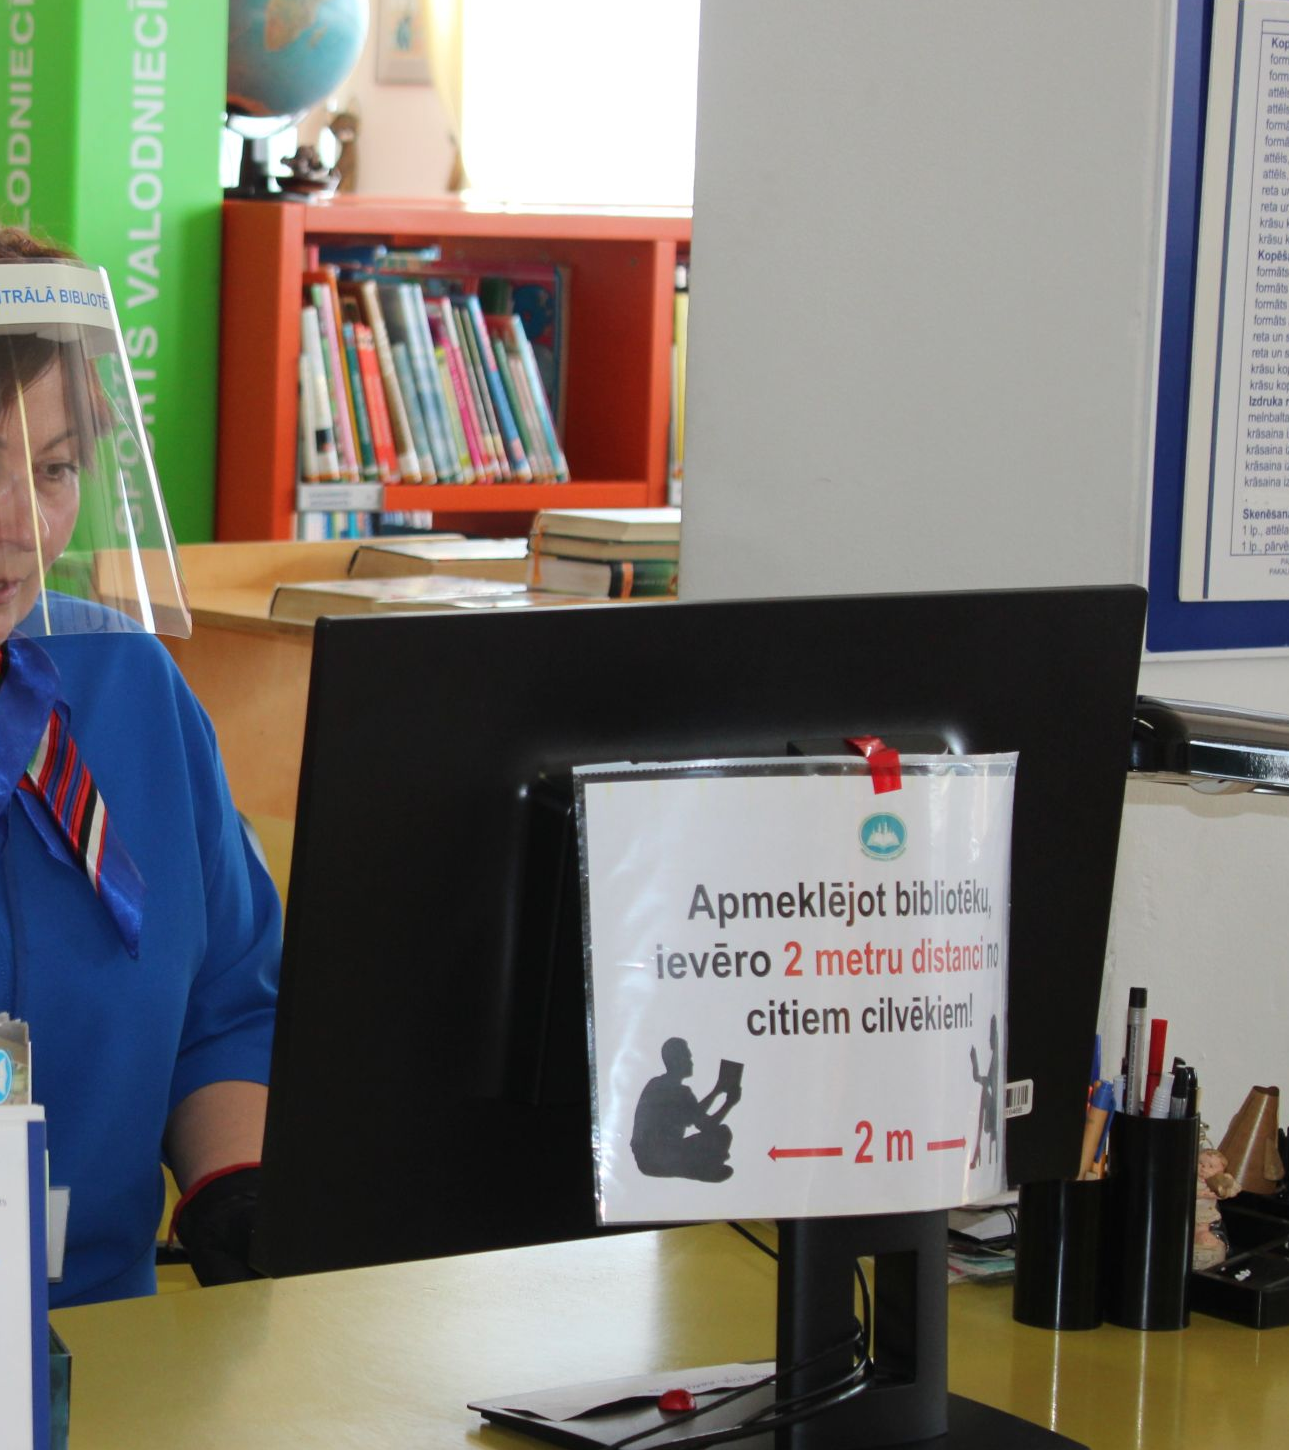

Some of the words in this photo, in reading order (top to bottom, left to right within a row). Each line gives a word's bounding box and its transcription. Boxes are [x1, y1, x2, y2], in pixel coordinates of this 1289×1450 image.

[687, 882, 887, 929] Apmeklējot
[895, 879, 992, 919] bibliotēku,
[656, 942, 772, 980] ievēro
[783, 941, 804, 977] 2
[815, 941, 903, 977] metru
[911, 936, 984, 974] distanci
[986, 942, 1000, 970] no
[747, 999, 851, 1036] citiem
[861, 993, 974, 1035] cilvēkiem!
[853, 1120, 874, 1163] 2
[886, 1128, 913, 1162] m
